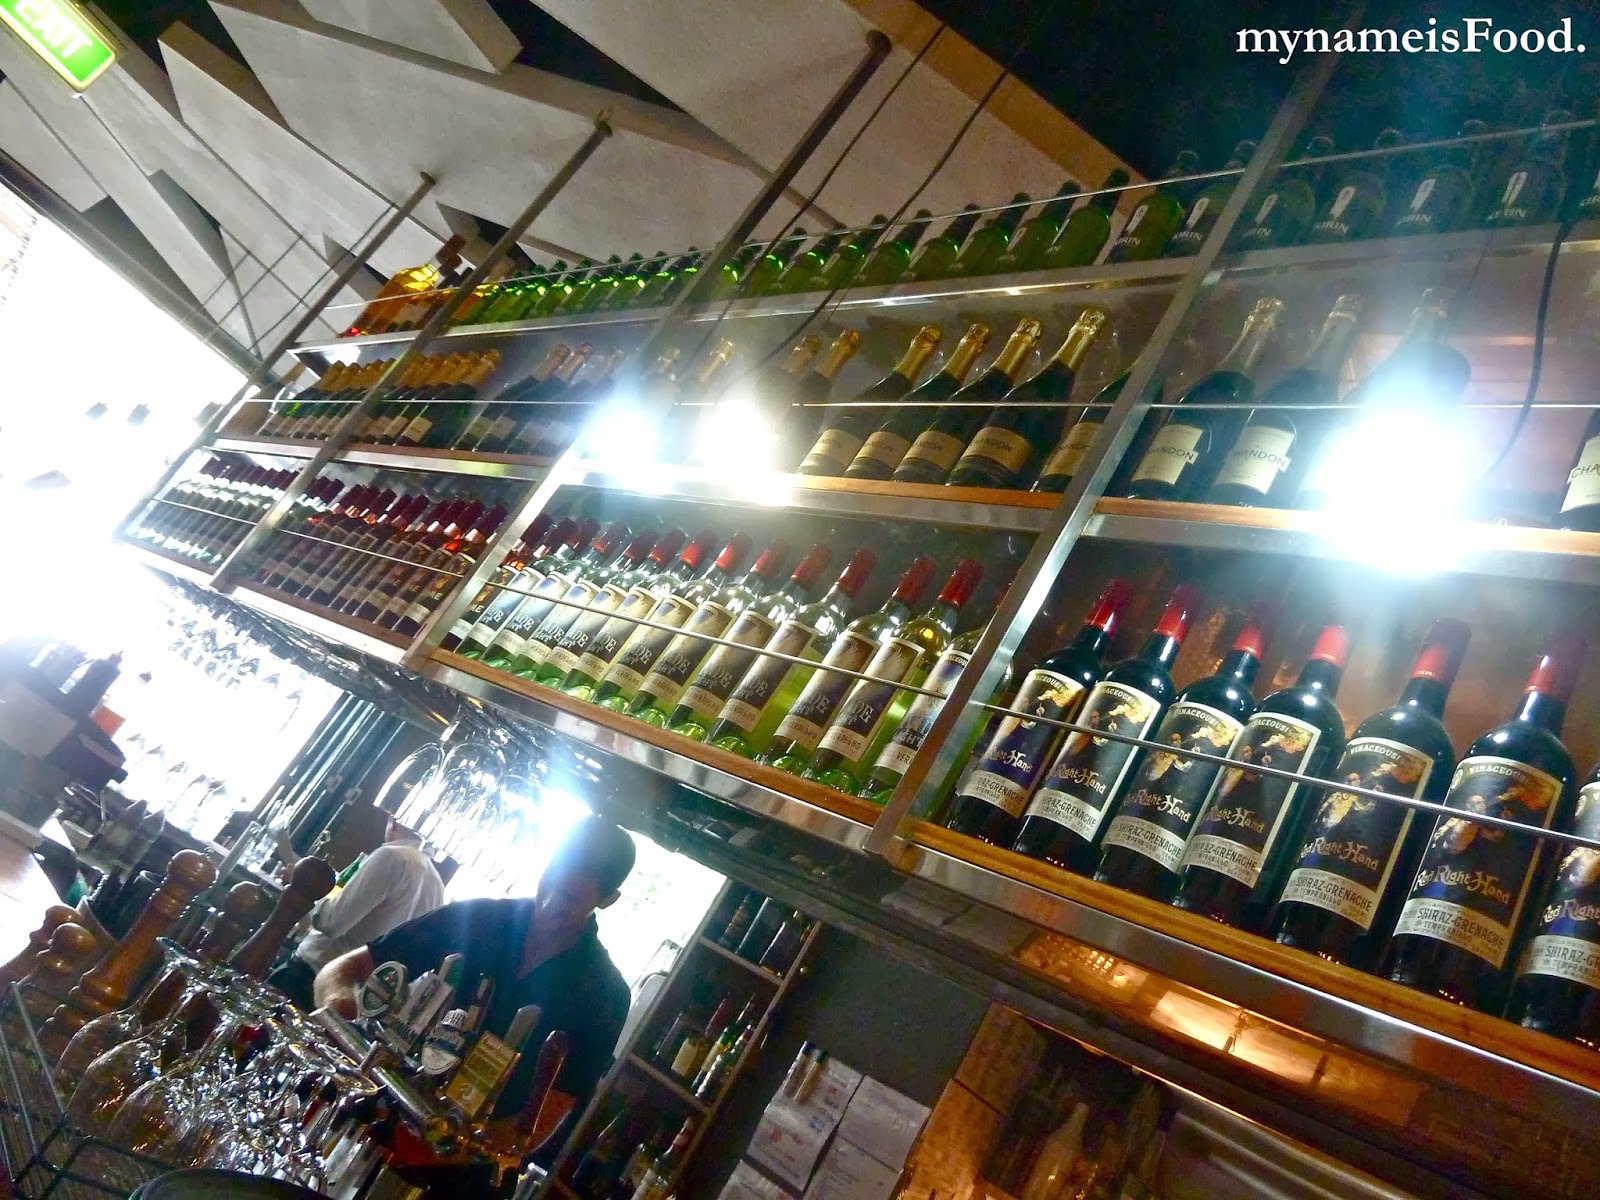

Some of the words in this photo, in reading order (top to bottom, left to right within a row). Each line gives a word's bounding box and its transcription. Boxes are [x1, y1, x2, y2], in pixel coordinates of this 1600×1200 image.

[13, 0, 93, 58] EXIT
[1074, 768, 1107, 795] Hand
[1157, 794, 1191, 823] Hand
[1228, 807, 1265, 834] Hand
[1313, 836, 1344, 857] Right
[1339, 841, 1379, 871] Hand
[1435, 864, 1470, 886] Right
[1467, 871, 1512, 904] Hand
